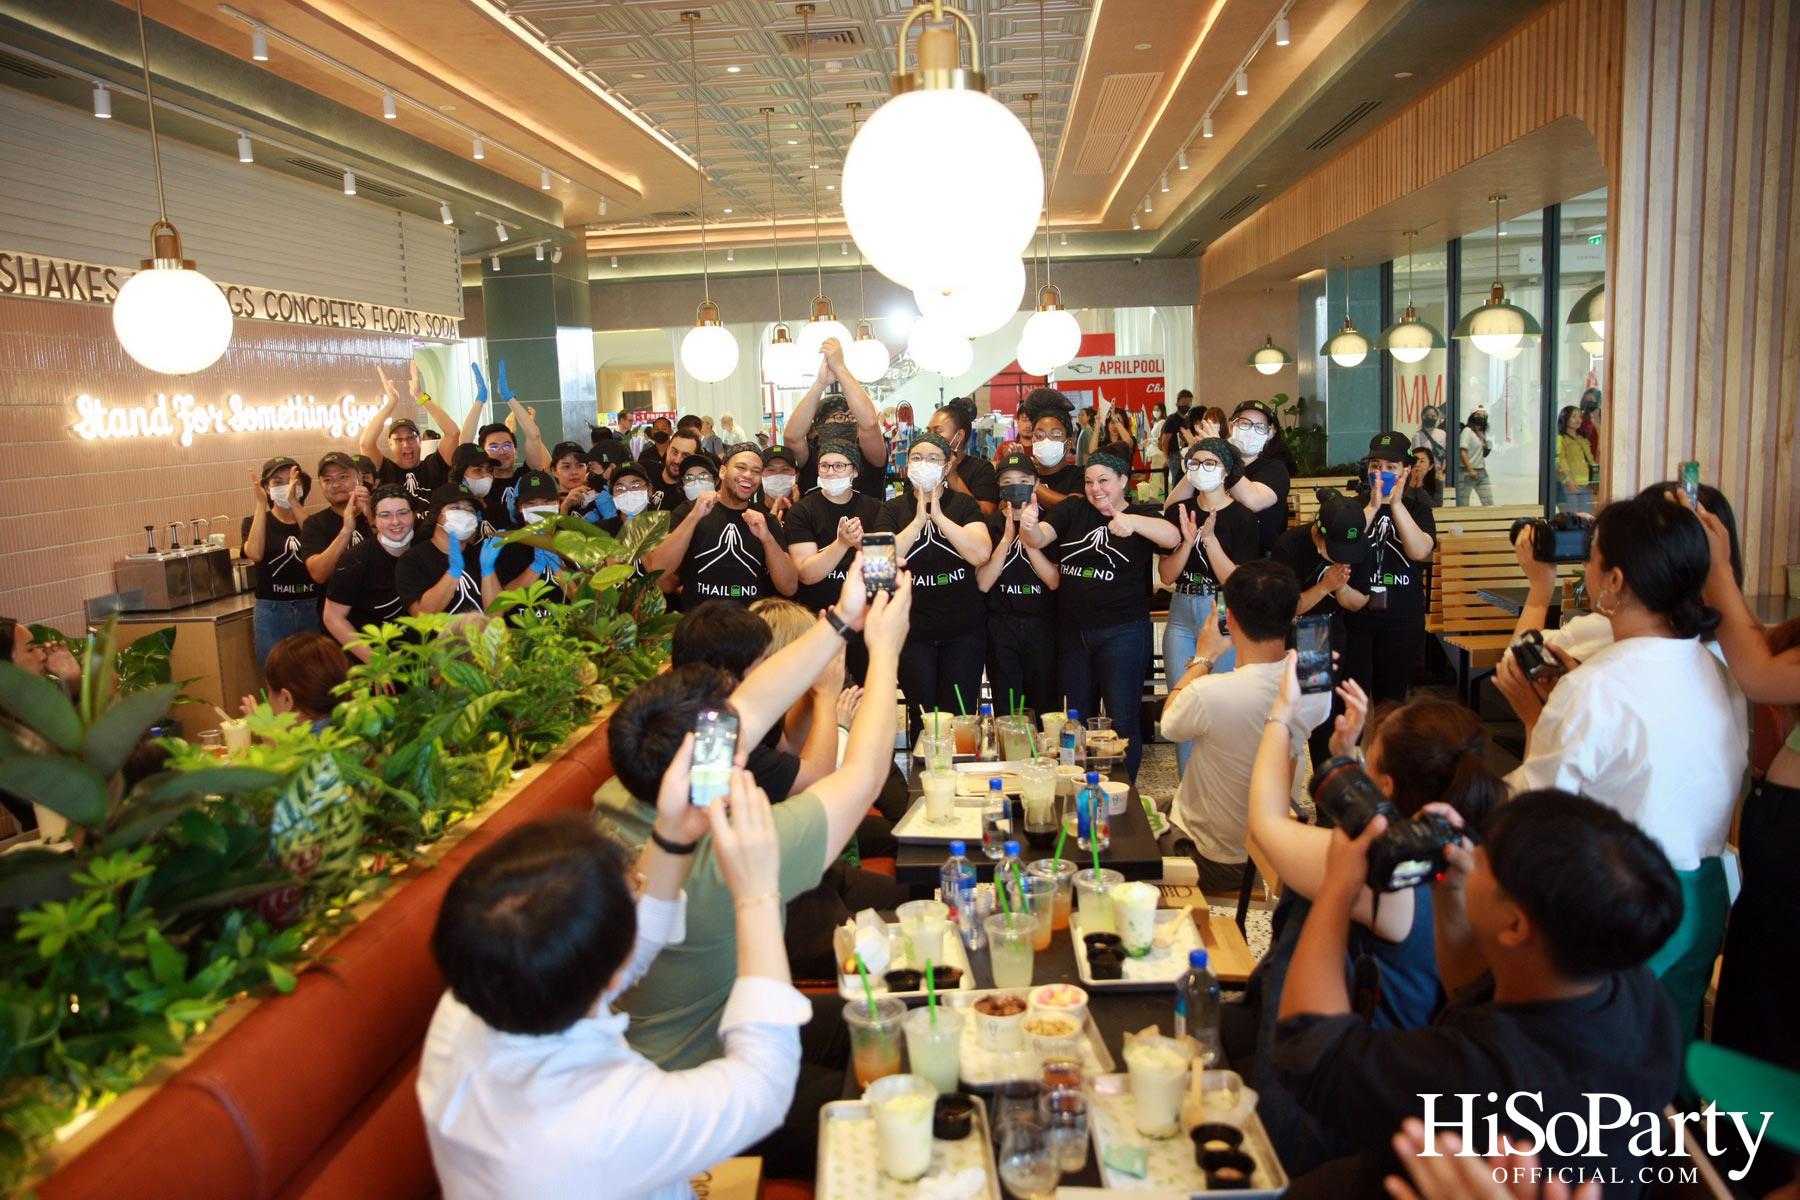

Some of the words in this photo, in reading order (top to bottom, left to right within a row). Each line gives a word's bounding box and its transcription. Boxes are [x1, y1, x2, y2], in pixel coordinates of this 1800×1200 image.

[0, 252, 120, 304] SHAKES
[263, 290, 367, 329] CONCRETES
[372, 305, 421, 335] FLOATS
[425, 314, 458, 340] SODA
[1099, 359, 1165, 375] APRILPOOL
[74, 394, 174, 440] Stand
[174, 394, 226, 447] For
[228, 394, 342, 438] Something
